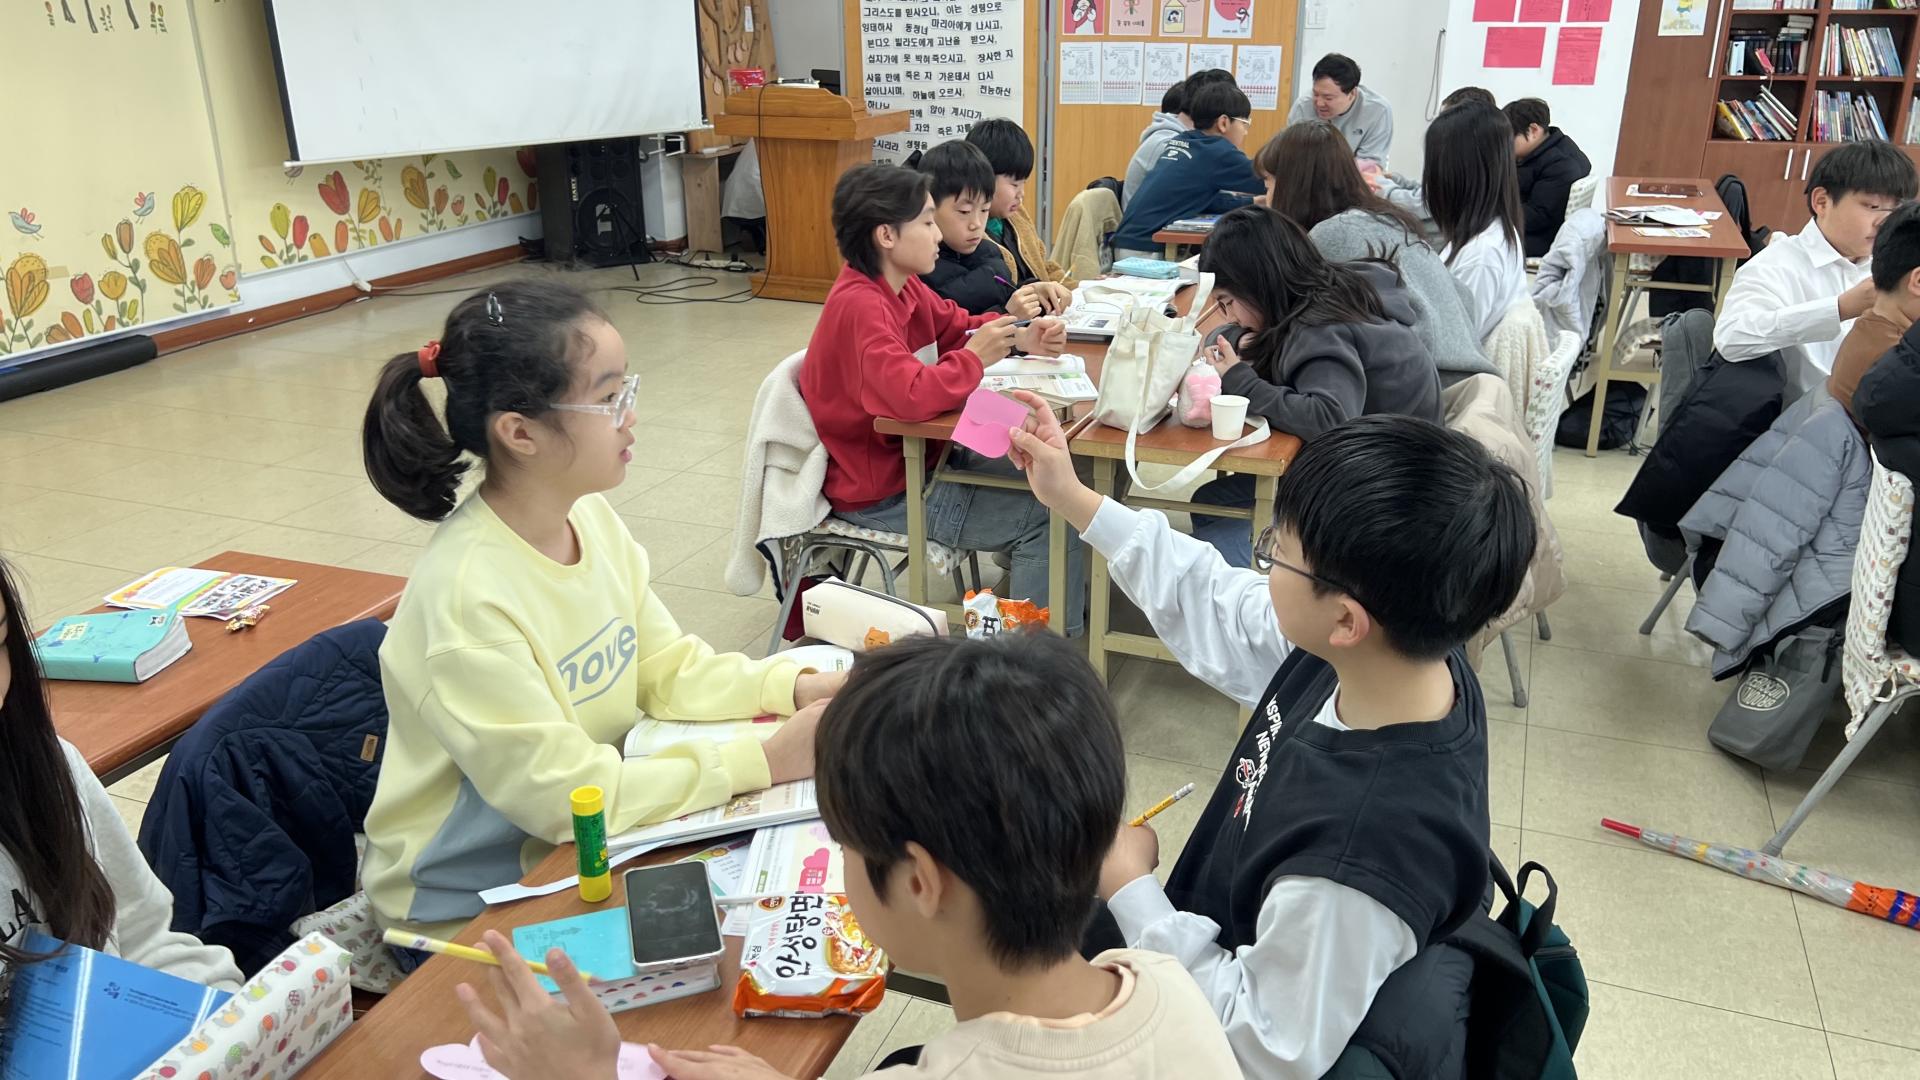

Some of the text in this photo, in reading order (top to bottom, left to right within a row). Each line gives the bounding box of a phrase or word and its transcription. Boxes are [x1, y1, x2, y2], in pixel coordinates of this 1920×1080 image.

[863, 7, 902, 18] 그리스도를
[946, 4, 962, 15] 이는
[969, 1, 1003, 14] 성령으로
[862, 22, 893, 33] 잉태하사
[905, 23, 929, 35] 동정녀
[931, 18, 972, 32] 마리아에게
[867, 38, 890, 49] 본디오
[895, 37, 934, 48] 빌라도에게
[937, 36, 961, 47] 고난을
[868, 54, 899, 65] 십자가에
[903, 54, 911, 64] 못
[977, 51, 1001, 63] 장사한
[1005, 49, 1014, 59] 지
[866, 70, 994, 83] 사흘 만에 죽은 자 가운데서 다시
[912, 90, 936, 100] 하늘에
[979, 84, 1012, 97] 전능하신
[930, 104, 945, 116] 앉아
[914, 123, 930, 133] 자와
[937, 126, 953, 137] 죽은
[905, 139, 928, 150] 성령을
[776, 891, 824, 978] 안성탕면
